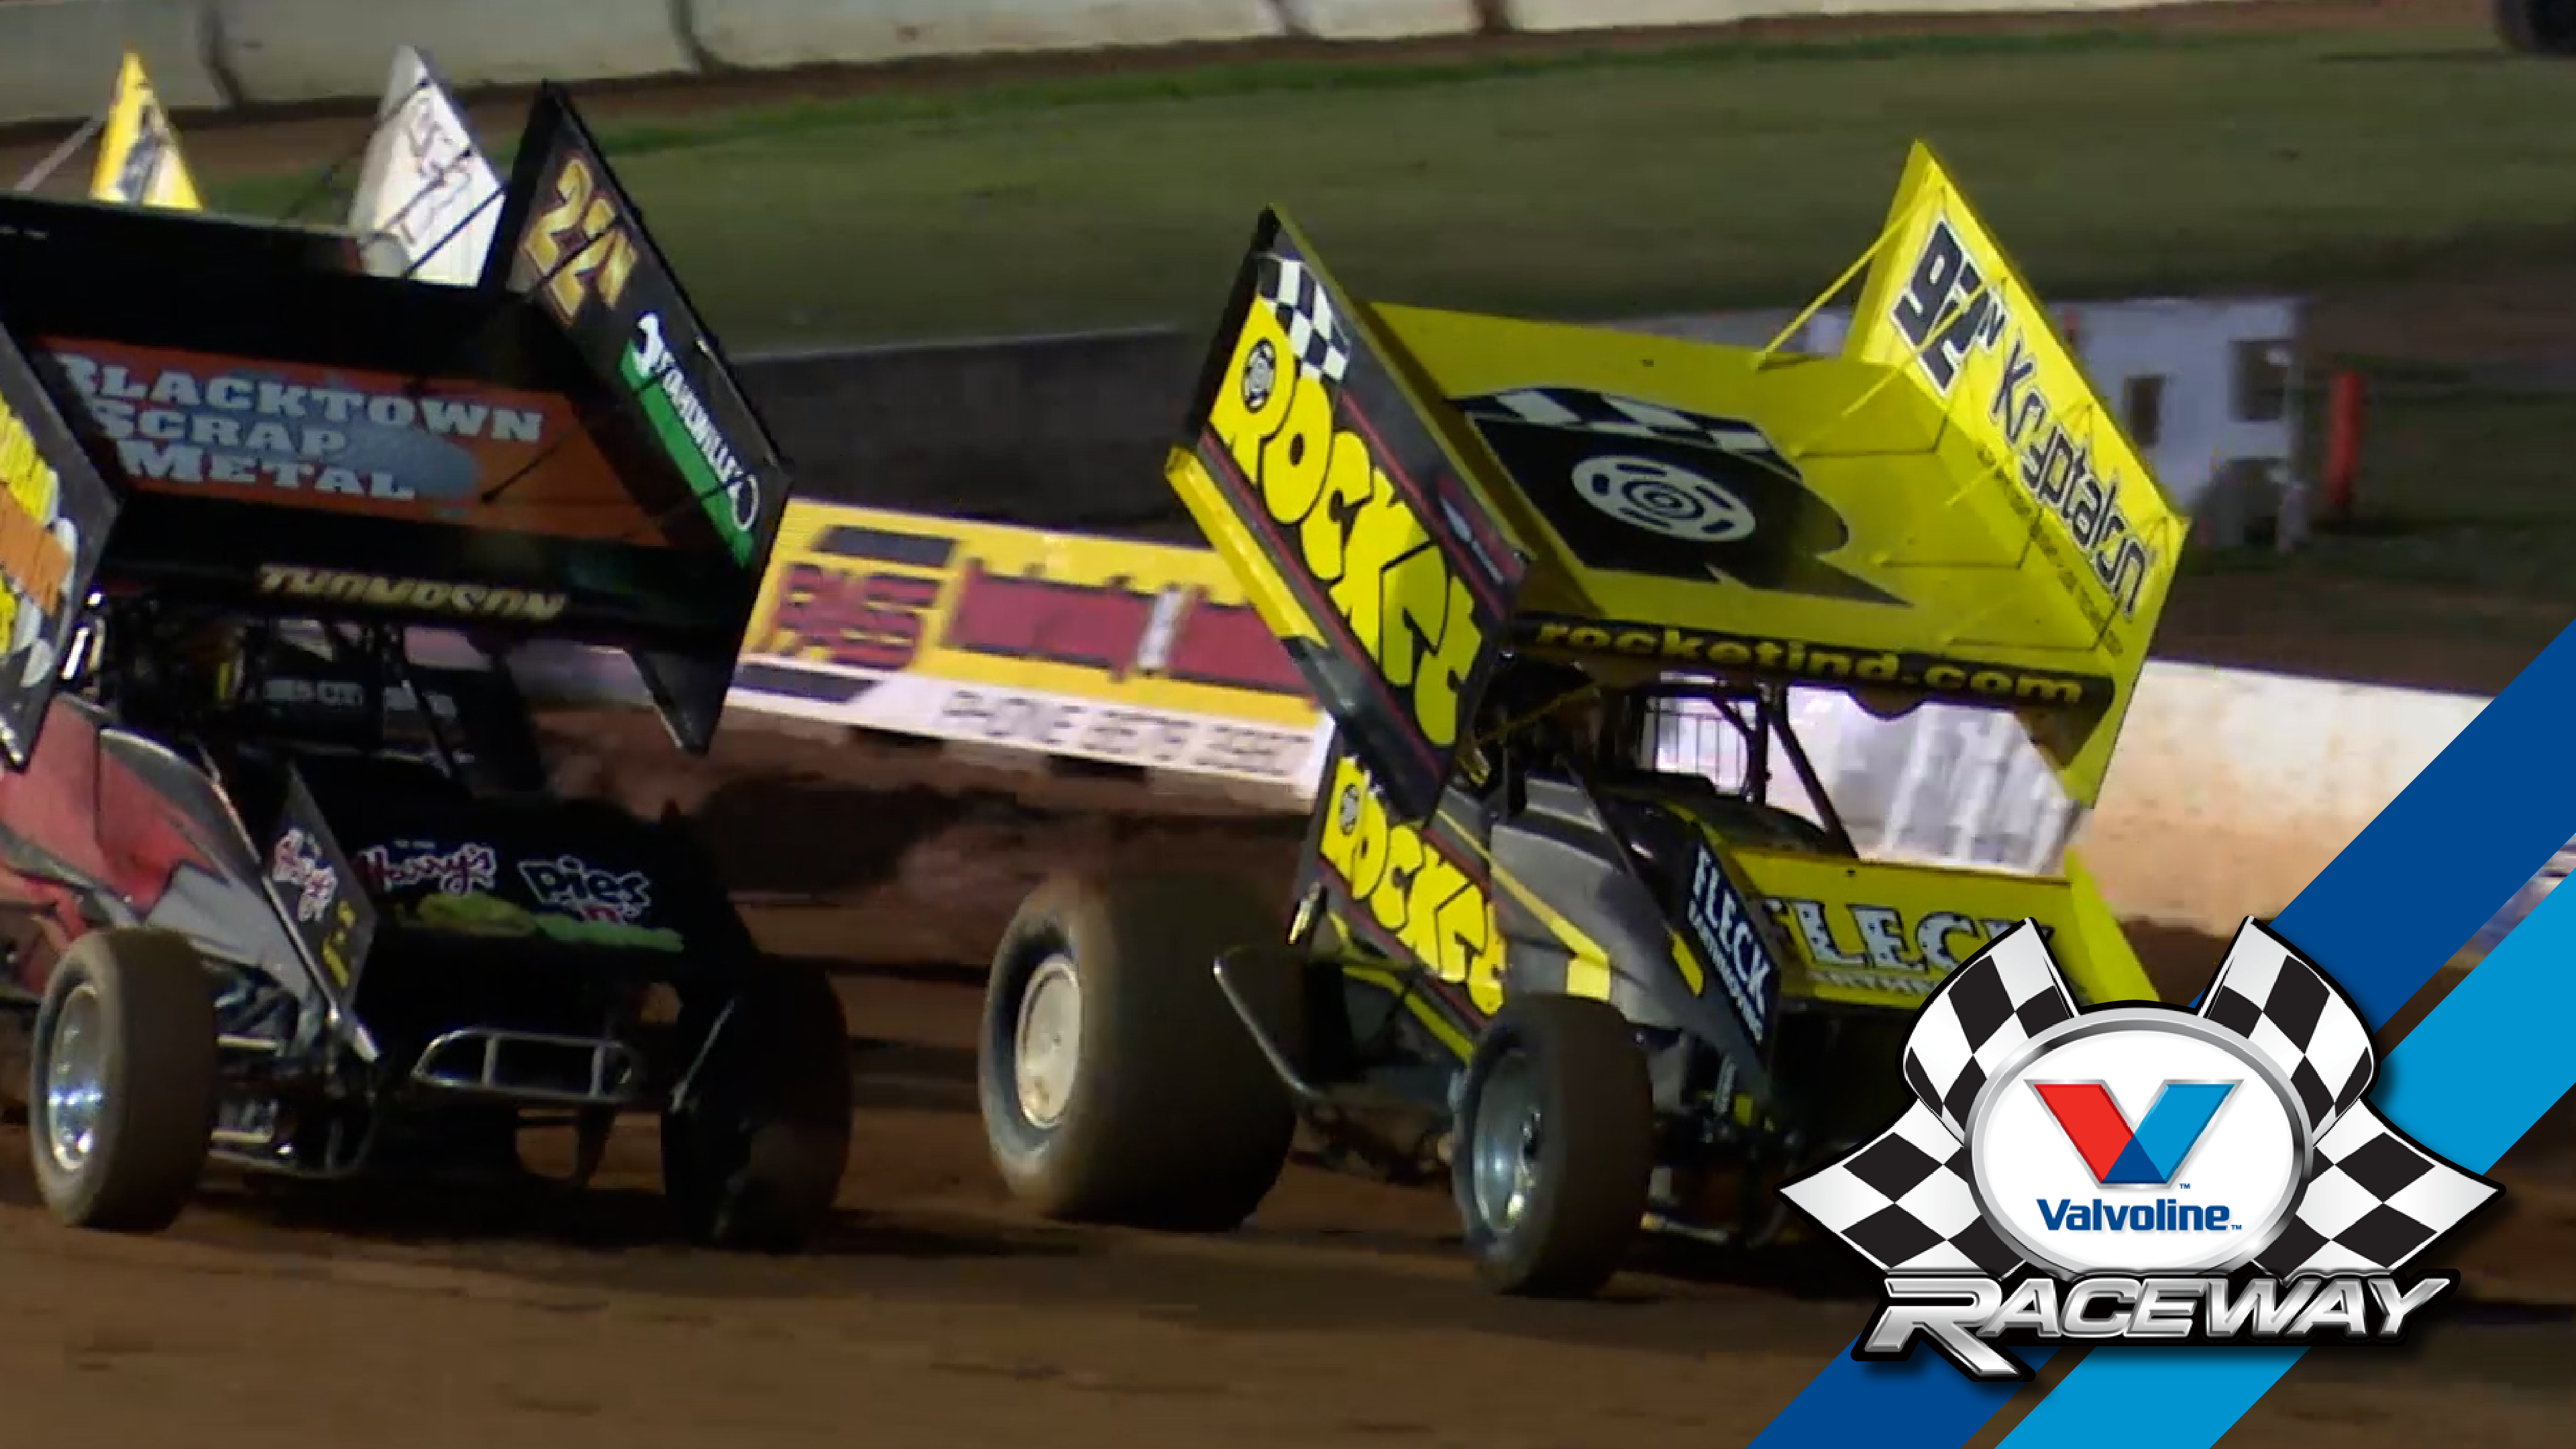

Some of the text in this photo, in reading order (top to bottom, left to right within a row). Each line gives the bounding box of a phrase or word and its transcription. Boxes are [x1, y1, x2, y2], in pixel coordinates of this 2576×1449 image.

[93, 400, 347, 459] SCRAP
[115, 440, 415, 500] METAL
[1535, 621, 2084, 704] rocketind.com
[1693, 843, 1770, 1015] FLECK
[1761, 896, 2055, 973] LEC
